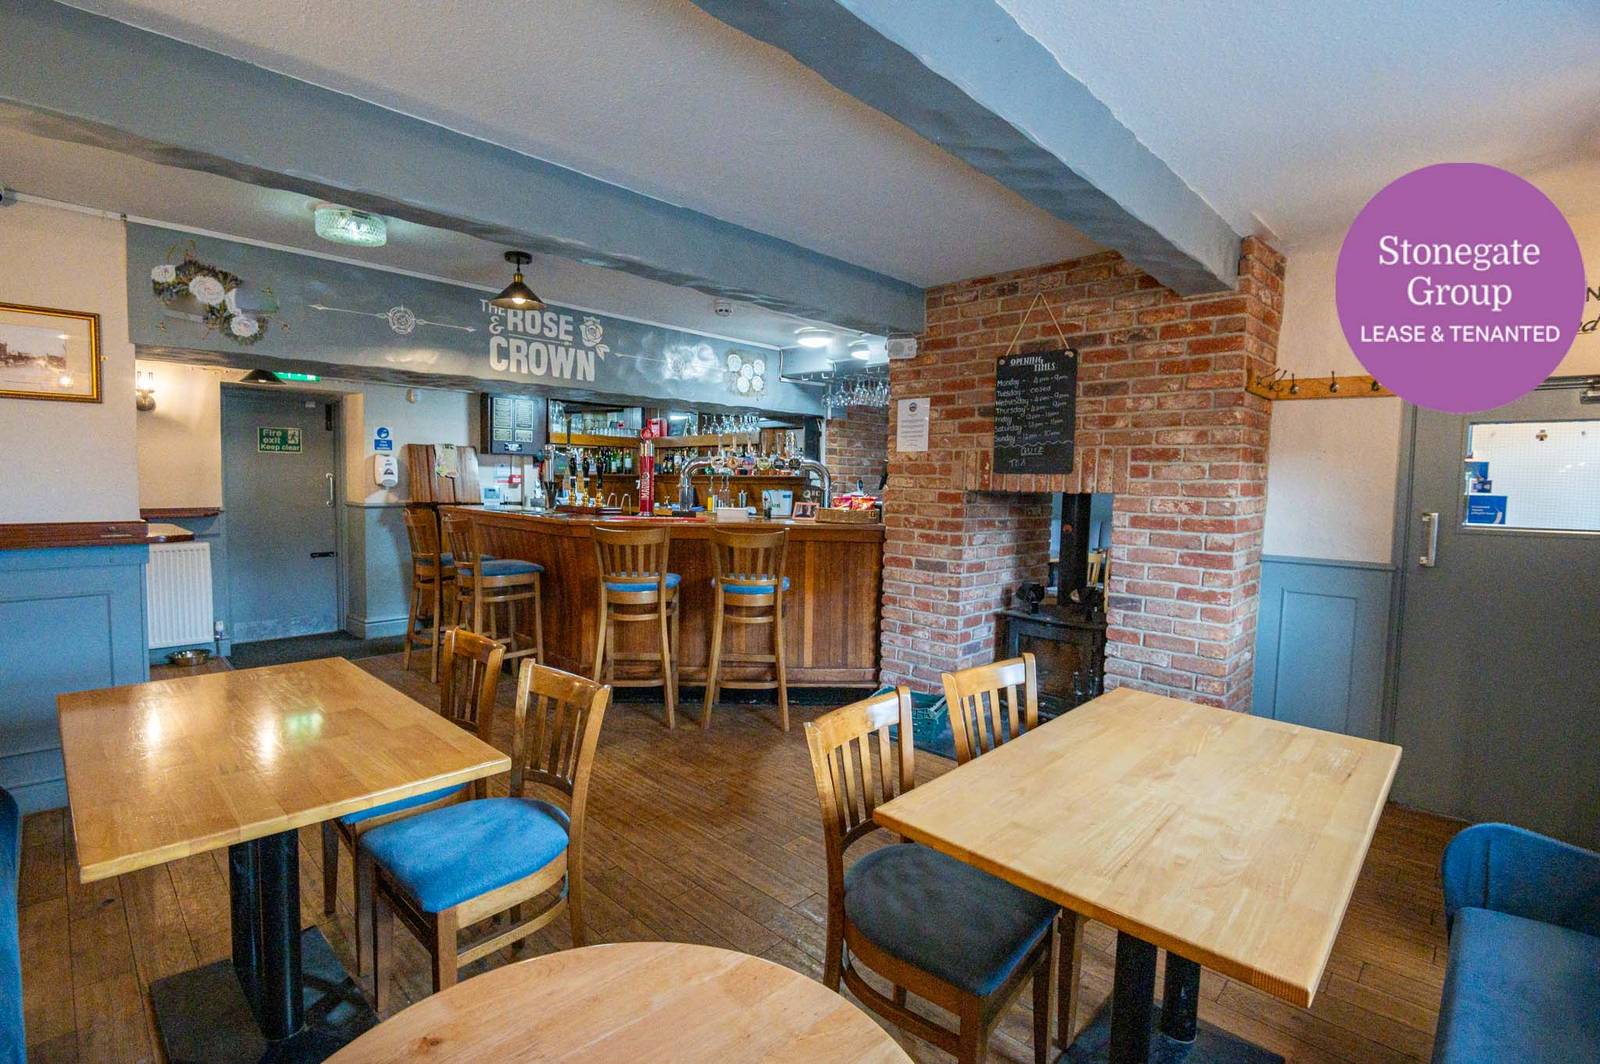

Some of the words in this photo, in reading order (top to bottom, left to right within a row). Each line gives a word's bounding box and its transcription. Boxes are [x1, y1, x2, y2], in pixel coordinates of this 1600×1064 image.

[480, 299, 506, 316] THE
[507, 308, 574, 341] ROSE
[489, 315, 504, 334] &
[489, 335, 595, 382] CROWN
[1010, 356, 1044, 366] OPENING
[262, 436, 281, 444] exit
[260, 443, 280, 452] Keep
[281, 443, 300, 451] clear
